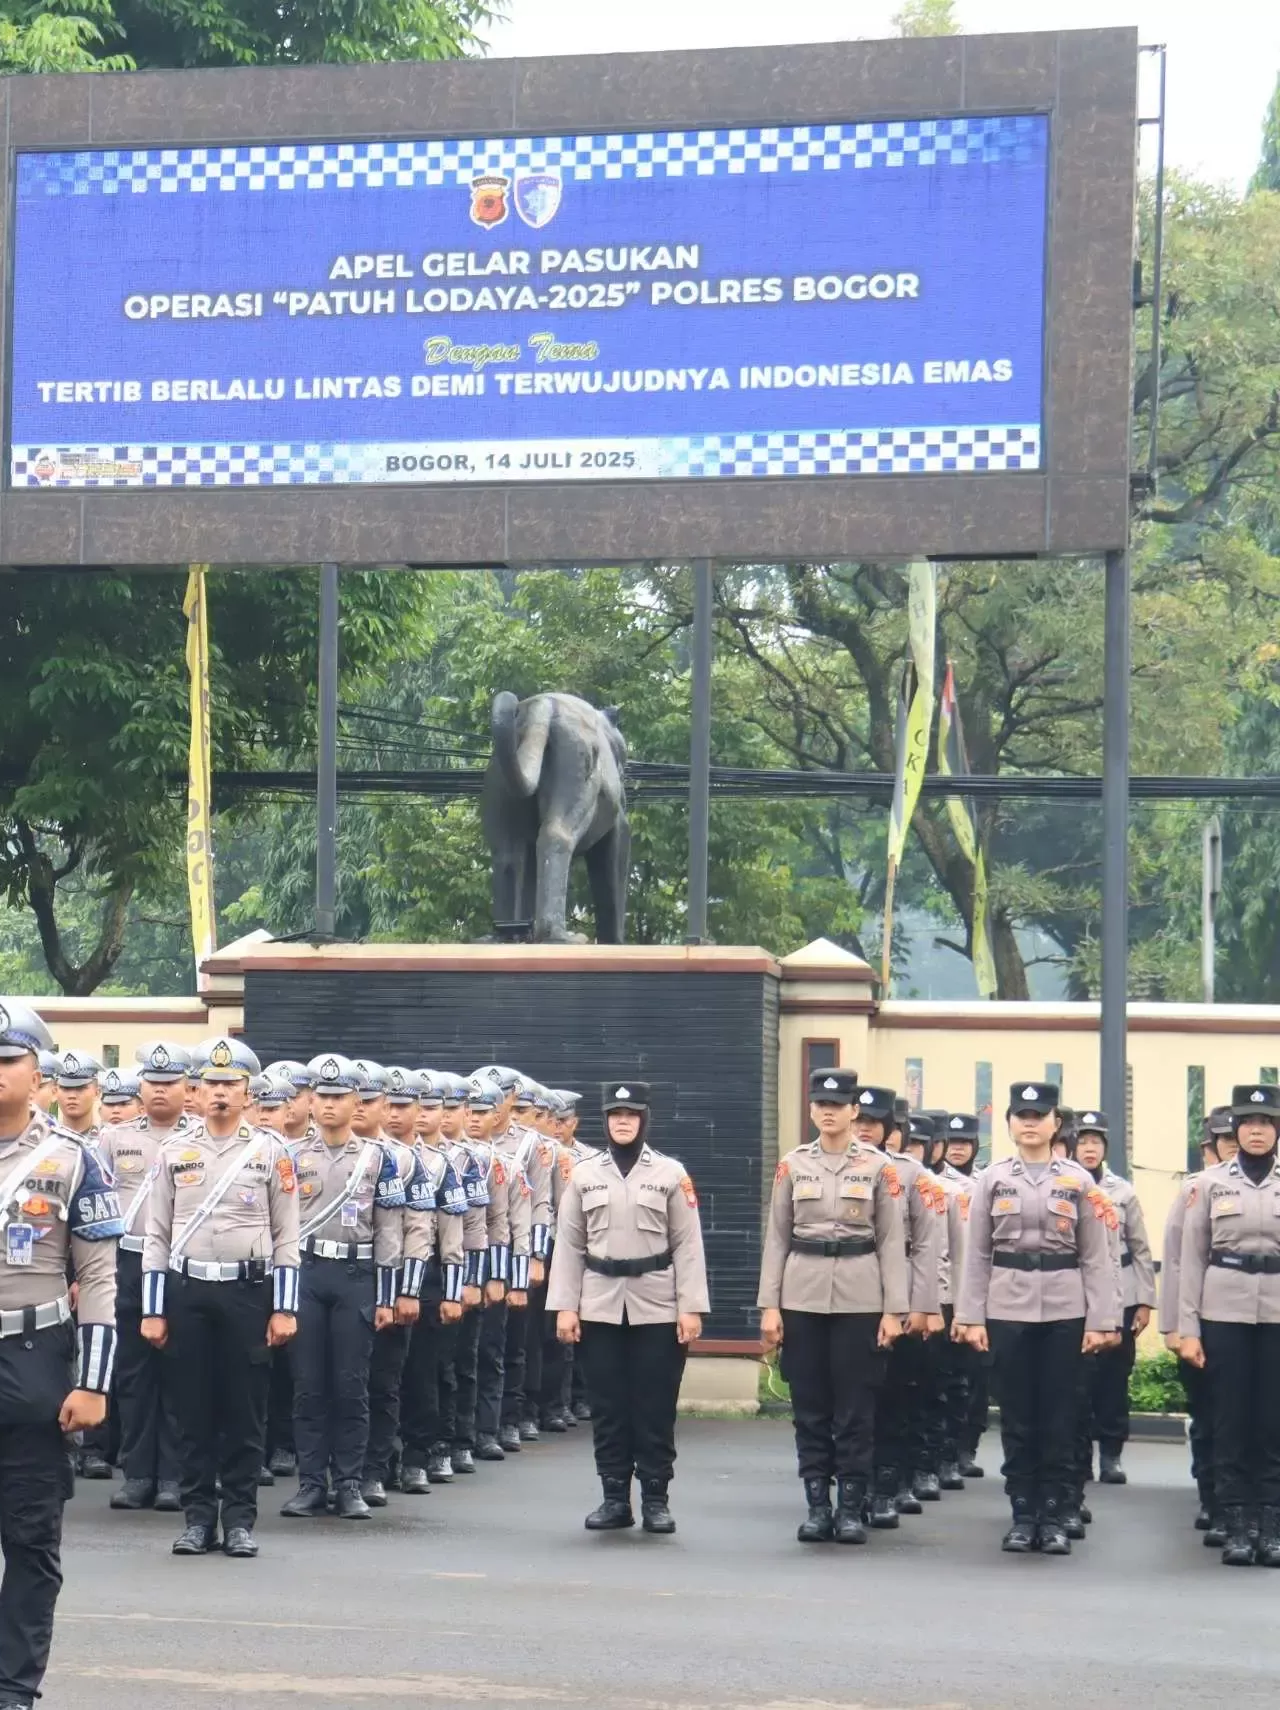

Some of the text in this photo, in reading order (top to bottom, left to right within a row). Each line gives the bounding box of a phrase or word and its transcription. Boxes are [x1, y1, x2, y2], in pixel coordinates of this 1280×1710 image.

[329, 245, 699, 280] APEL GELAR PASUKAN
[124, 273, 920, 319] OPERASI “PATUH LODAYA-2025” POLRES BOGOR
[424, 332, 599, 371] Dengan Tema
[37, 359, 1013, 403] TERTIB BERLALU LINTAS DEMI TERWUJUDNYA INDONESIA EMAS
[385, 451, 636, 473] BOGOR, 14 JULI 2025
[17, 1178, 61, 1193] OLRI
